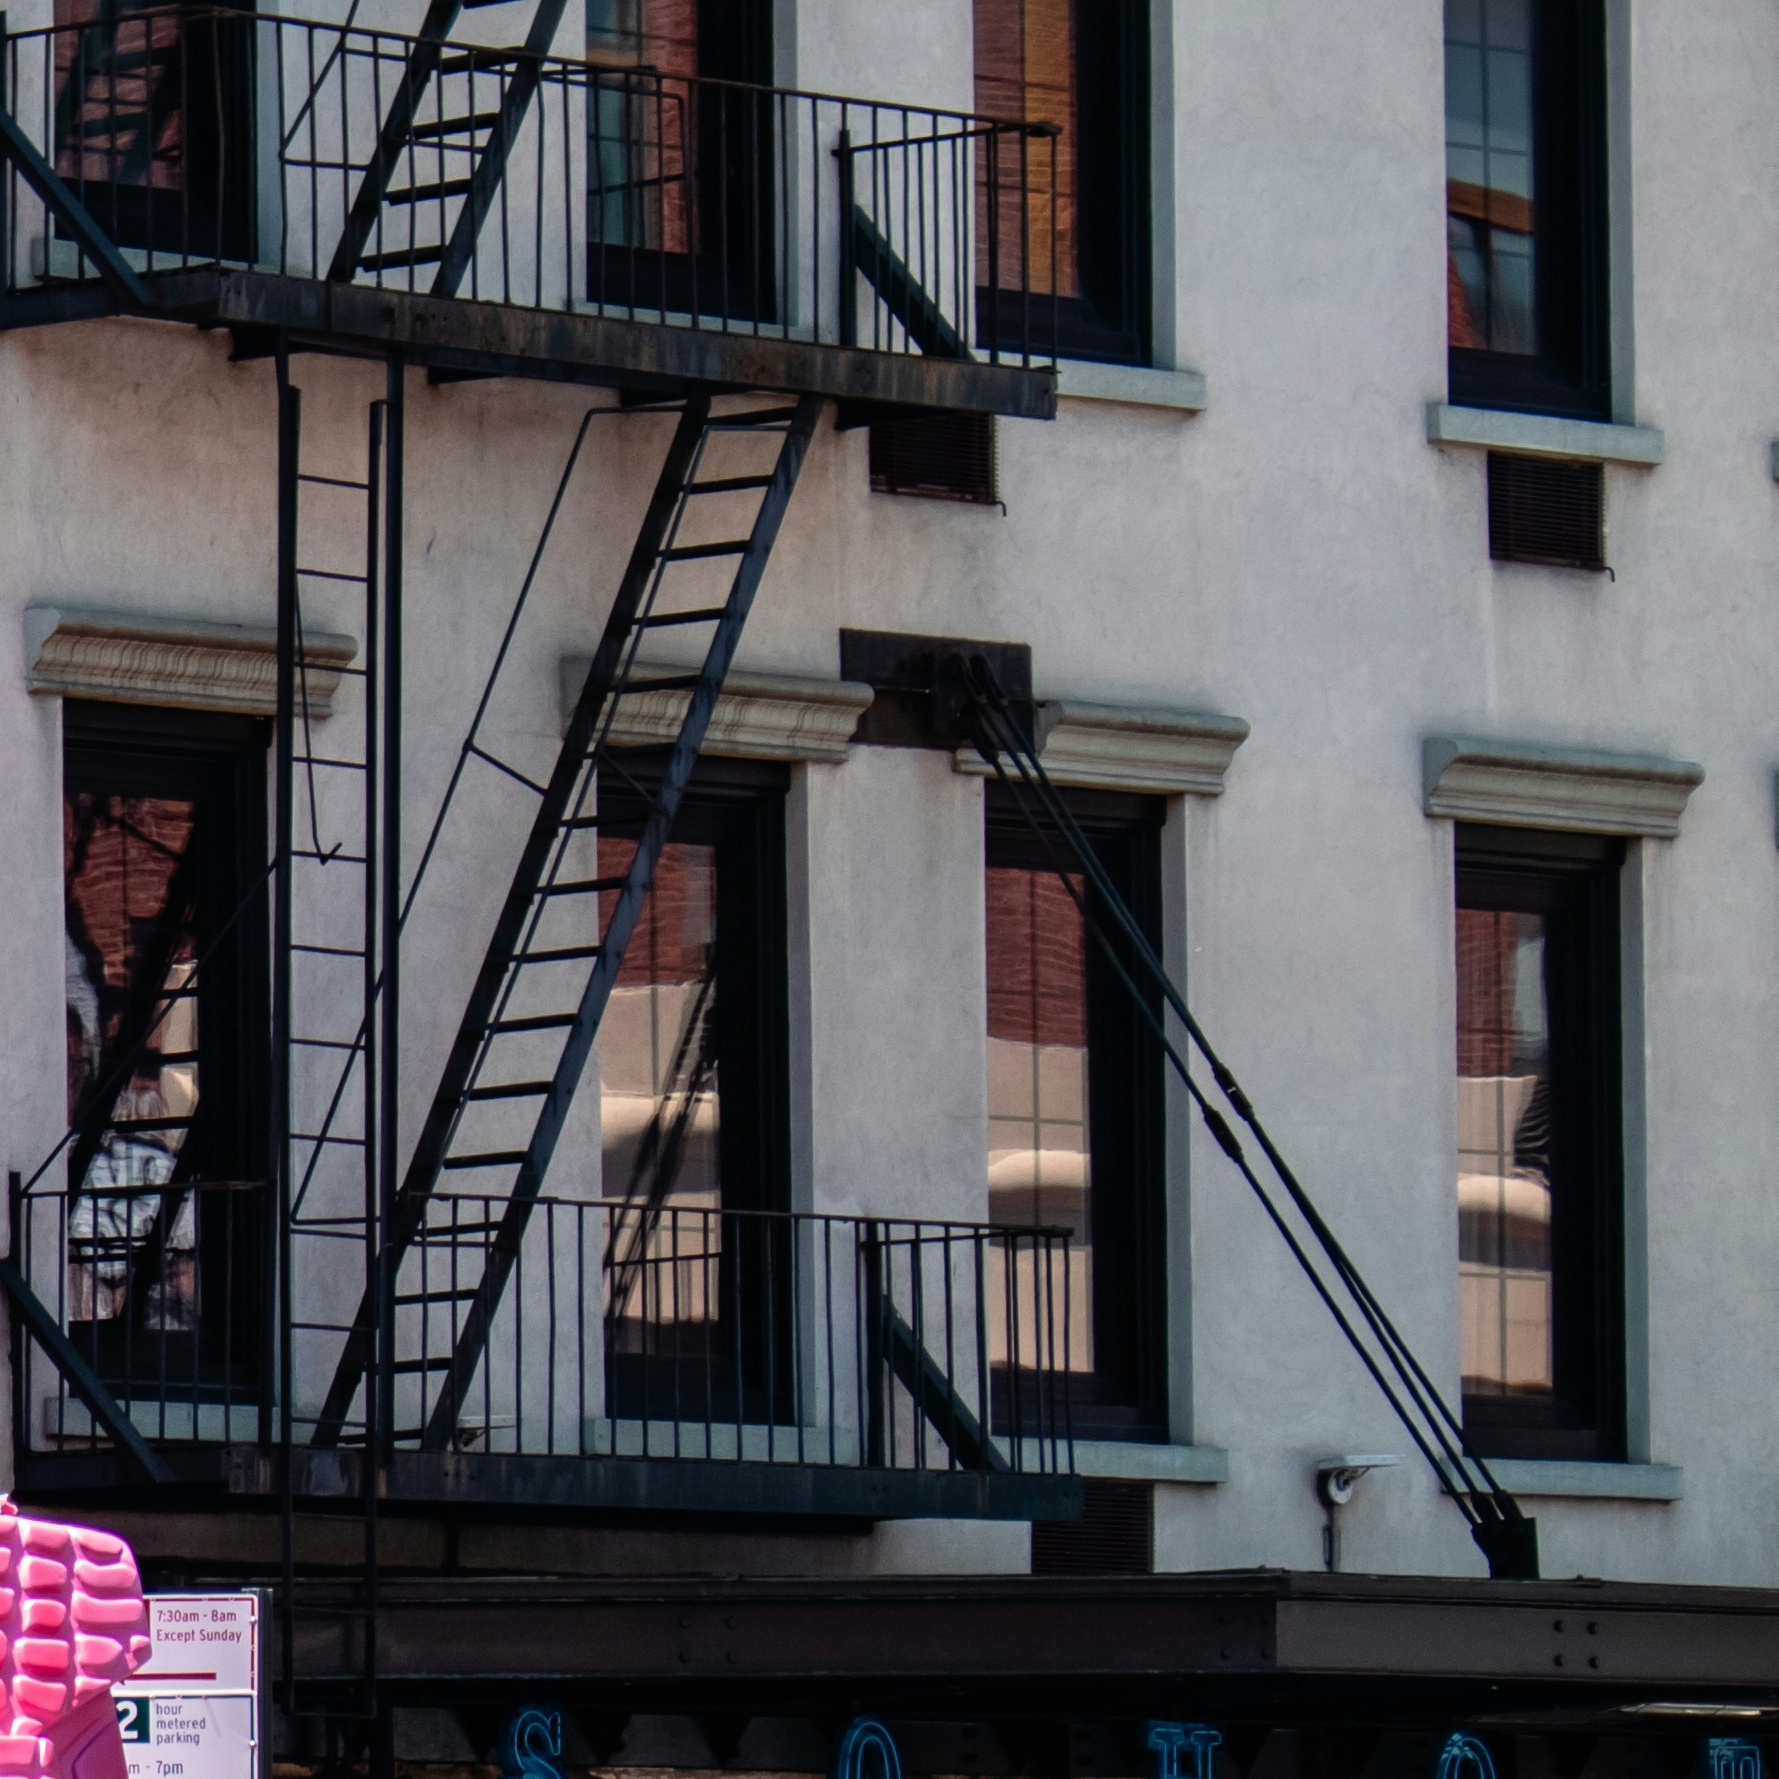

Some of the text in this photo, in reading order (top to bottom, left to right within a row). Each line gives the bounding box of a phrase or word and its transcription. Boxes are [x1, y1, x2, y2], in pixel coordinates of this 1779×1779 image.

[157, 1609, 199, 1622] 7:30am
[211, 1609, 237, 1622] 8am
[156, 1629, 242, 1644] Except Sunday
[156, 1703, 183, 1715] hour
[116, 1700, 139, 1739] 2
[156, 1717, 206, 1729] metered
[156, 1731, 200, 1746] parking
[156, 1760, 184, 1777] 7pm
